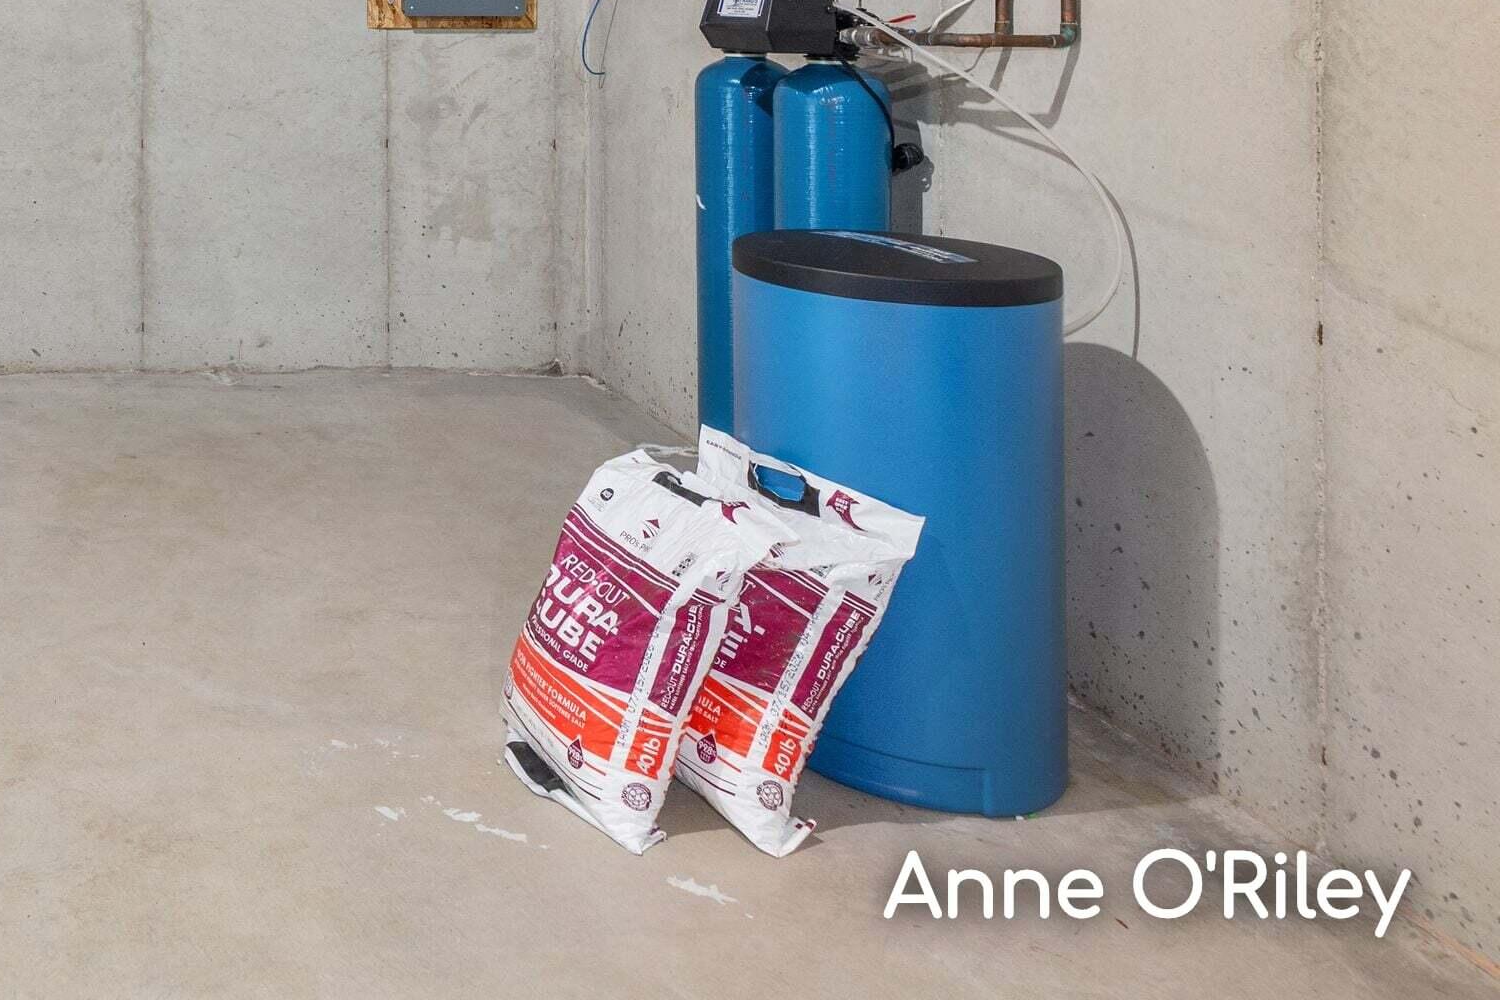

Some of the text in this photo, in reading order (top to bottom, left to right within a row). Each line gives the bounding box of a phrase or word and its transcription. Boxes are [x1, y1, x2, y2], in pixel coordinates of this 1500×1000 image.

[536, 588, 605, 663] UBE
[548, 683, 586, 719] FORMULA
[773, 738, 797, 775] 40 lb
